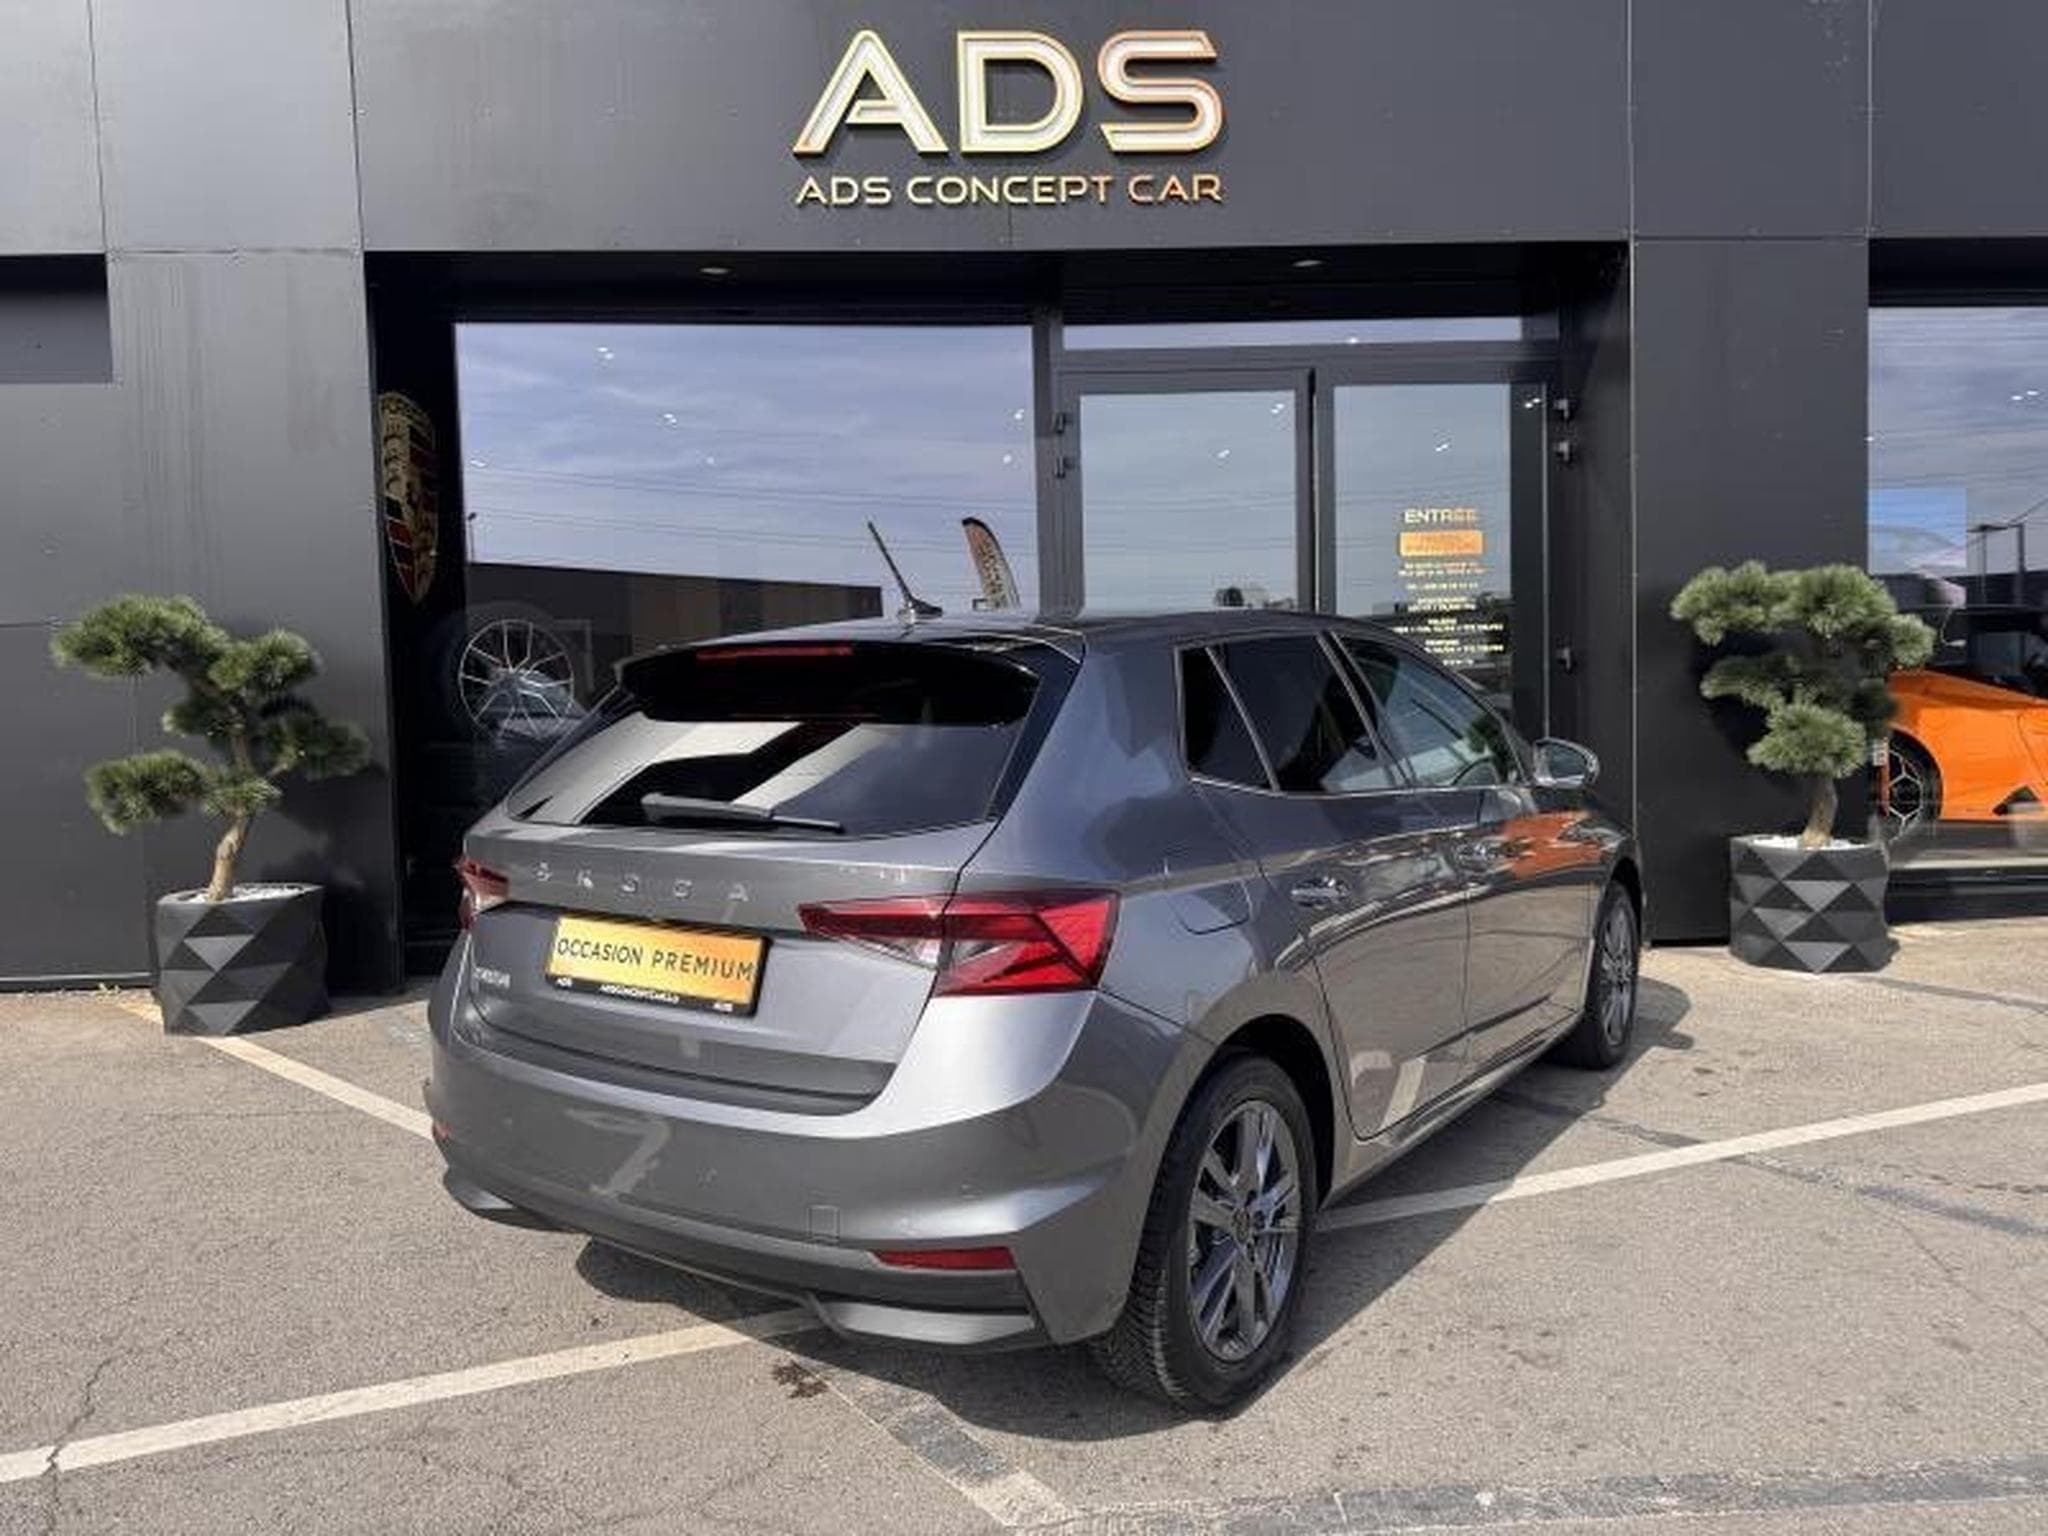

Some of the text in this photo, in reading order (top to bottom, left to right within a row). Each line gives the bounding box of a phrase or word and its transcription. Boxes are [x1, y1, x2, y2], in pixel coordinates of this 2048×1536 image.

[793, 29, 1223, 155] ADS
[796, 174, 1223, 206] ADS CONCEPT CAR
[557, 938, 754, 982] OCCASION PREMIUM
